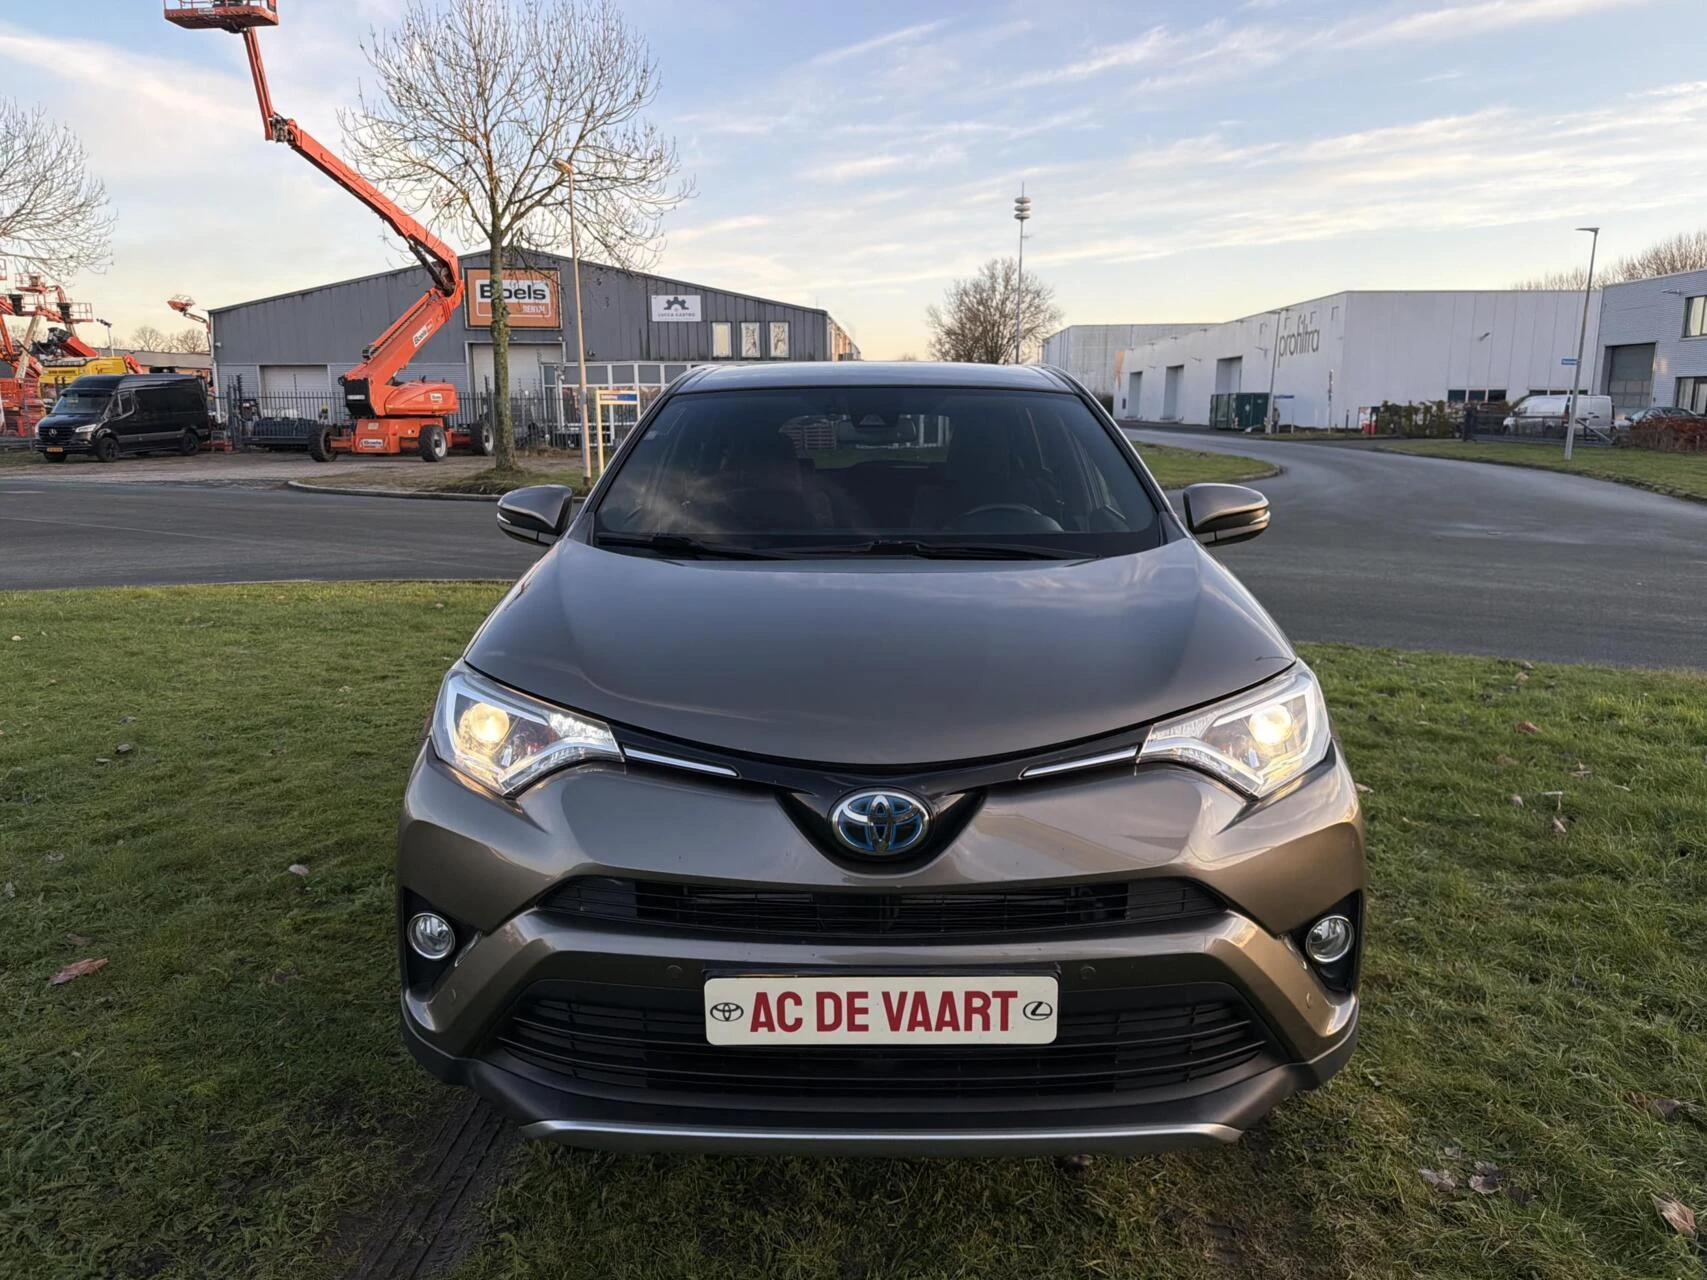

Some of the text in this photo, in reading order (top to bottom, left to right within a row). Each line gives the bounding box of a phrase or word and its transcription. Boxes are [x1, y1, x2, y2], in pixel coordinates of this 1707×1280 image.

[750, 990, 1018, 1033] AC DE VAART
